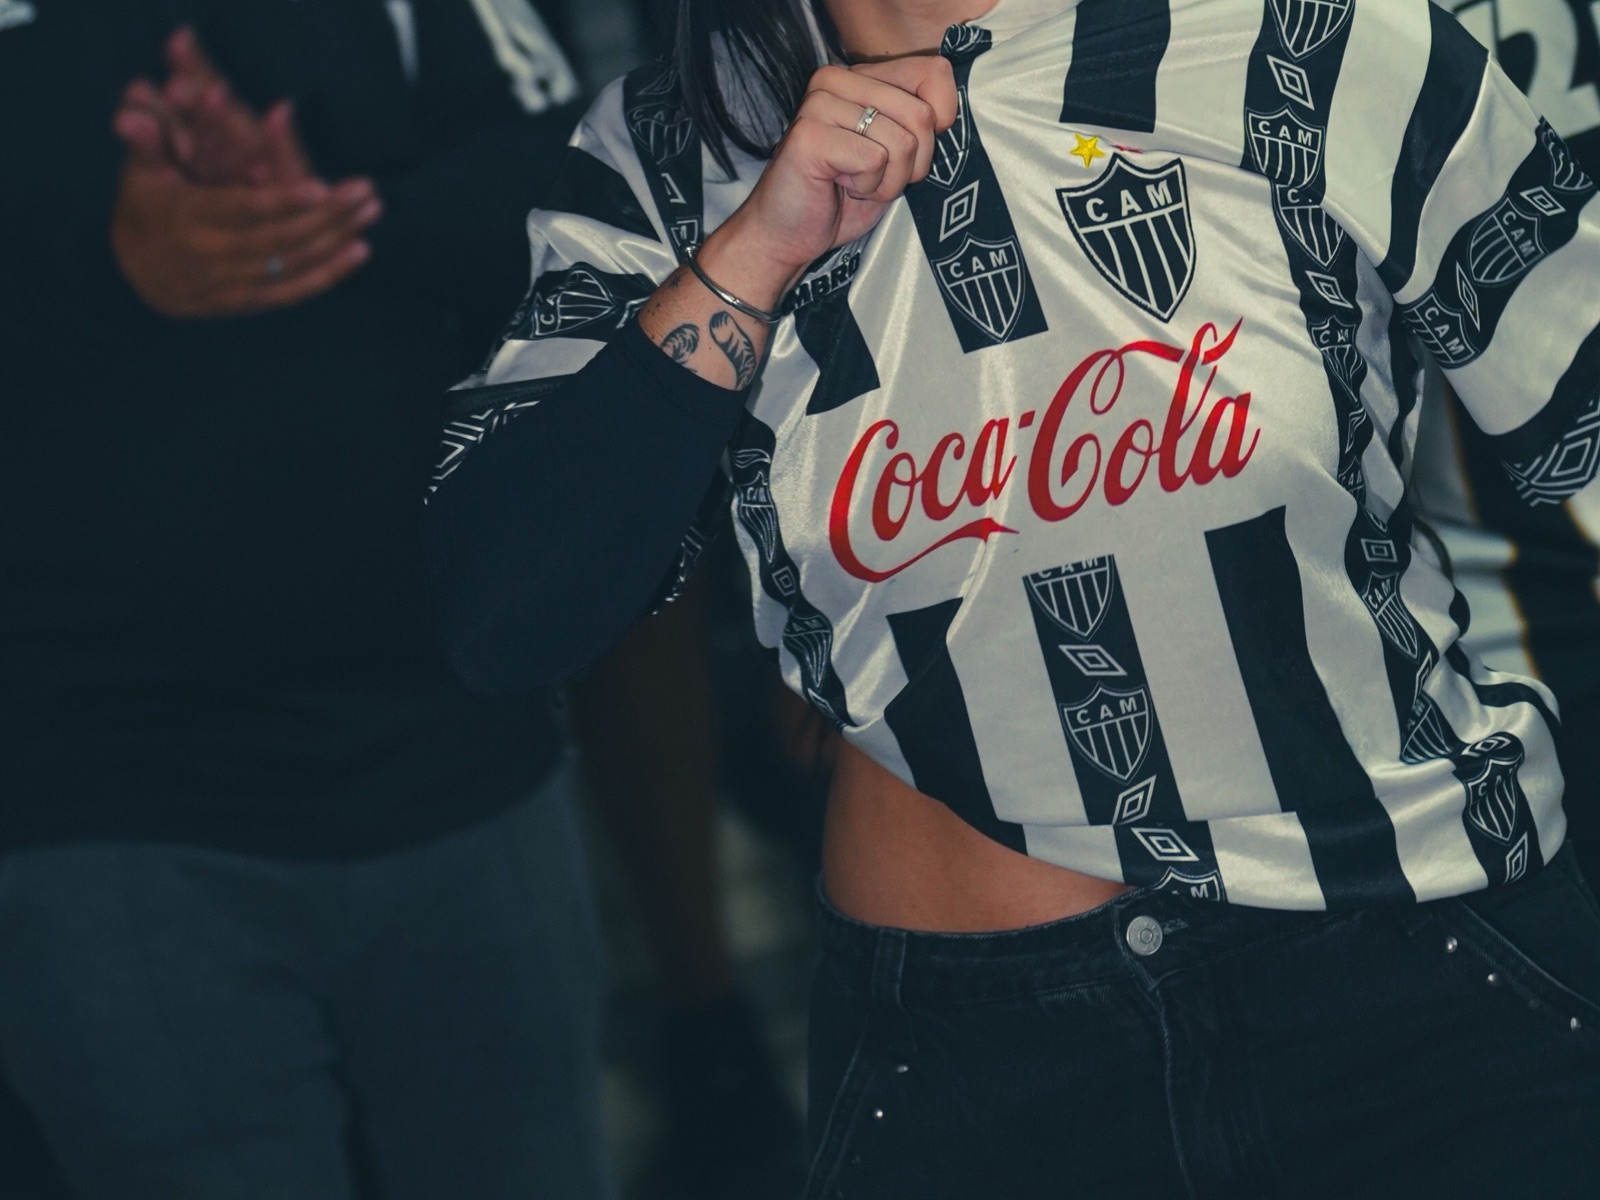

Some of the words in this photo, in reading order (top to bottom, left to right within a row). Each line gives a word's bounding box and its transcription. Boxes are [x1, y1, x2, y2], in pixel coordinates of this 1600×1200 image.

[1258, 120, 1313, 147] CAM
[1085, 179, 1173, 223] CAM
[1502, 211, 1536, 258] CAM
[949, 248, 1009, 278] CAM
[1424, 306, 1466, 356] CAM
[828, 315, 1262, 583] Coca-Cola
[1367, 578, 1392, 610] CAM
[1076, 696, 1138, 725] CAM
